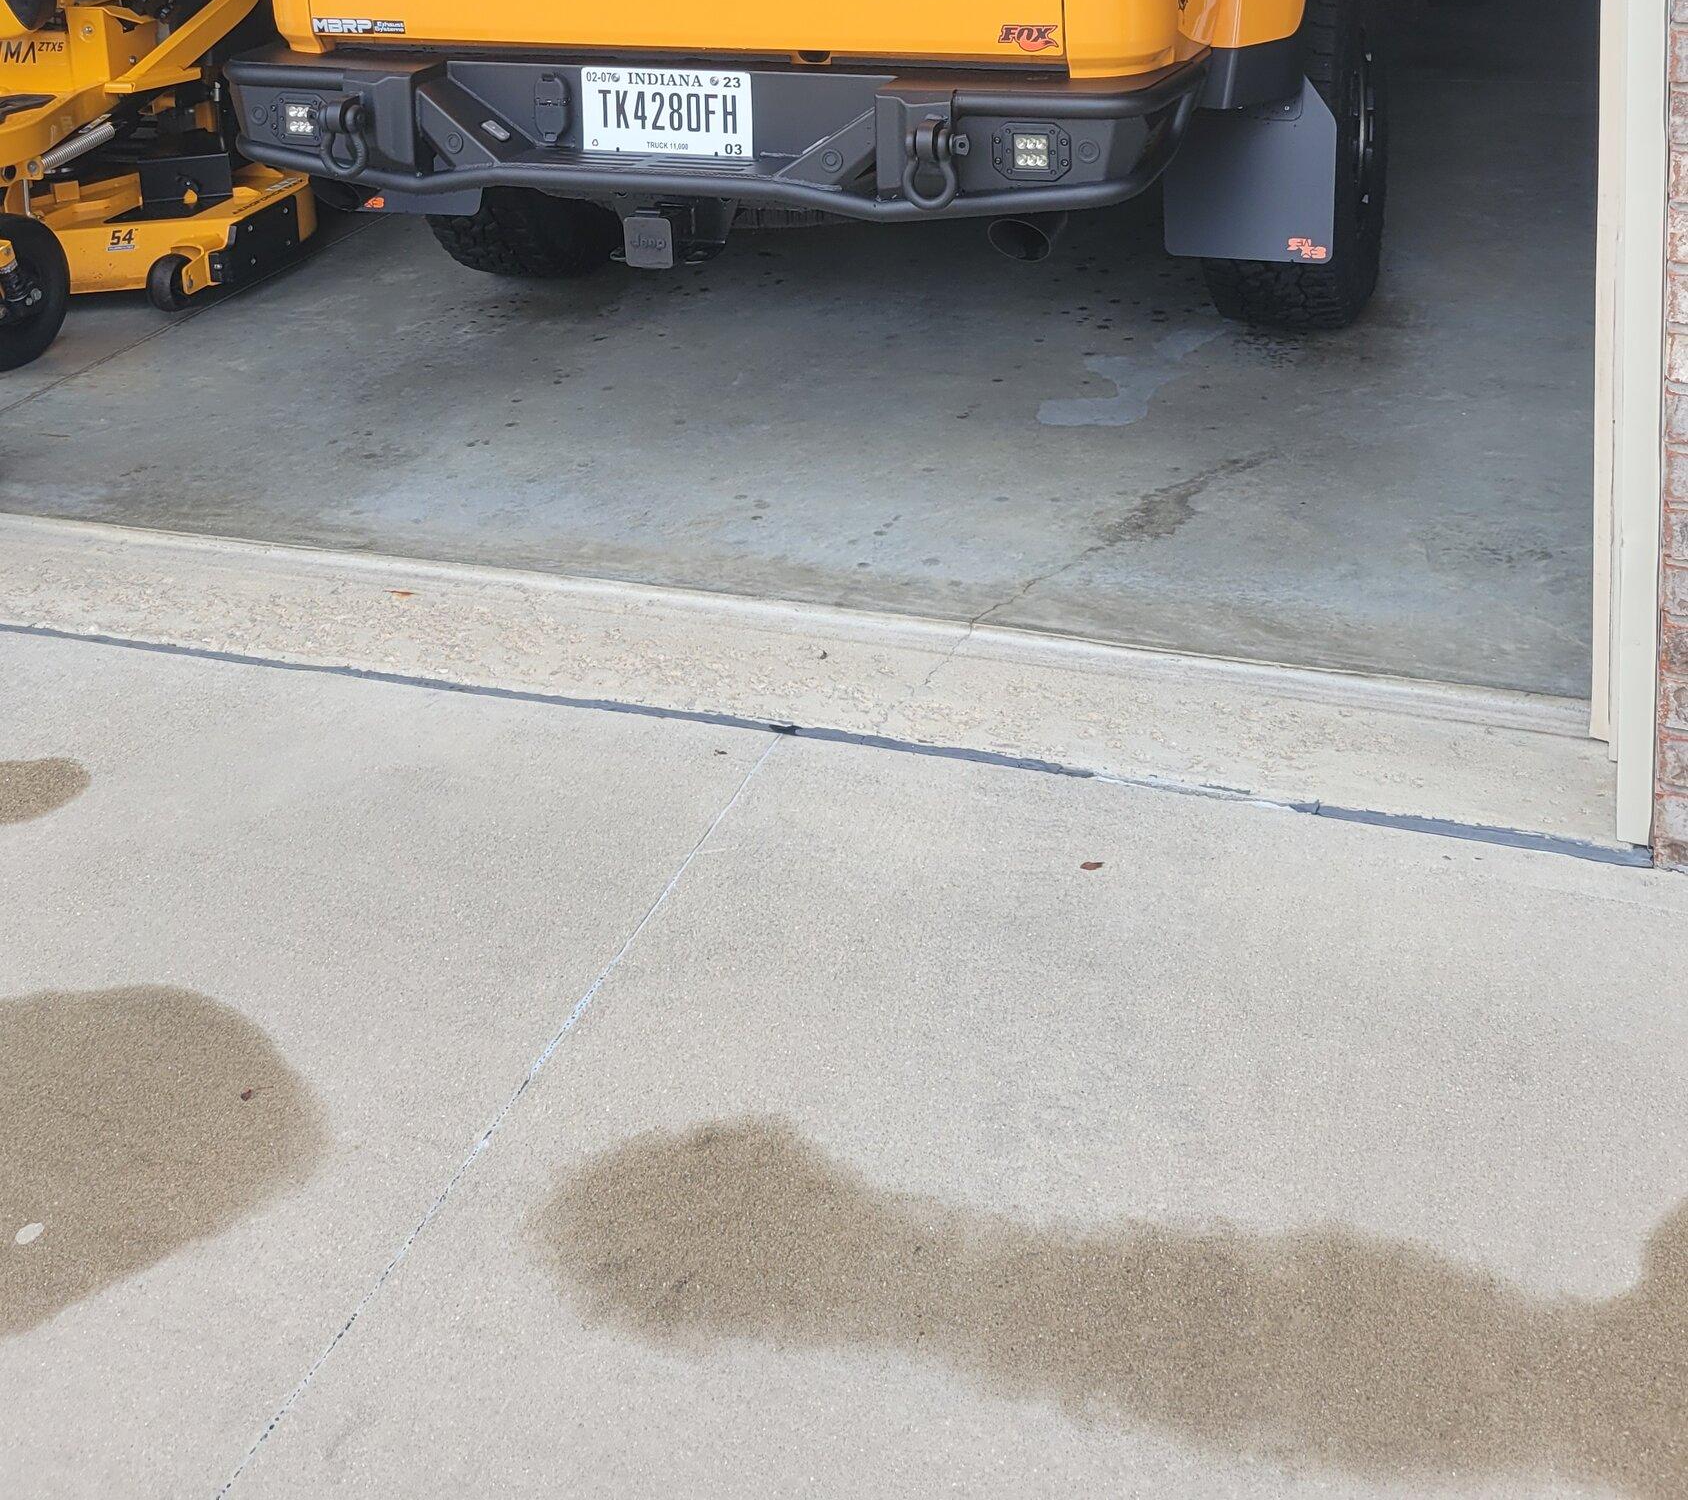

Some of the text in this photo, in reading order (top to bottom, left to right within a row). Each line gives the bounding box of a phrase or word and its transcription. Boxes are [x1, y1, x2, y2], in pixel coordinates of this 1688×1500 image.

[312, 18, 373, 34] MBRP
[1000, 25, 1056, 44] FOX
[37, 41, 64, 52] ZTX5
[627, 72, 703, 88] INDIANA
[723, 77, 741, 89] 23
[646, 141, 669, 150] TRUCK
[724, 143, 743, 155] 03
